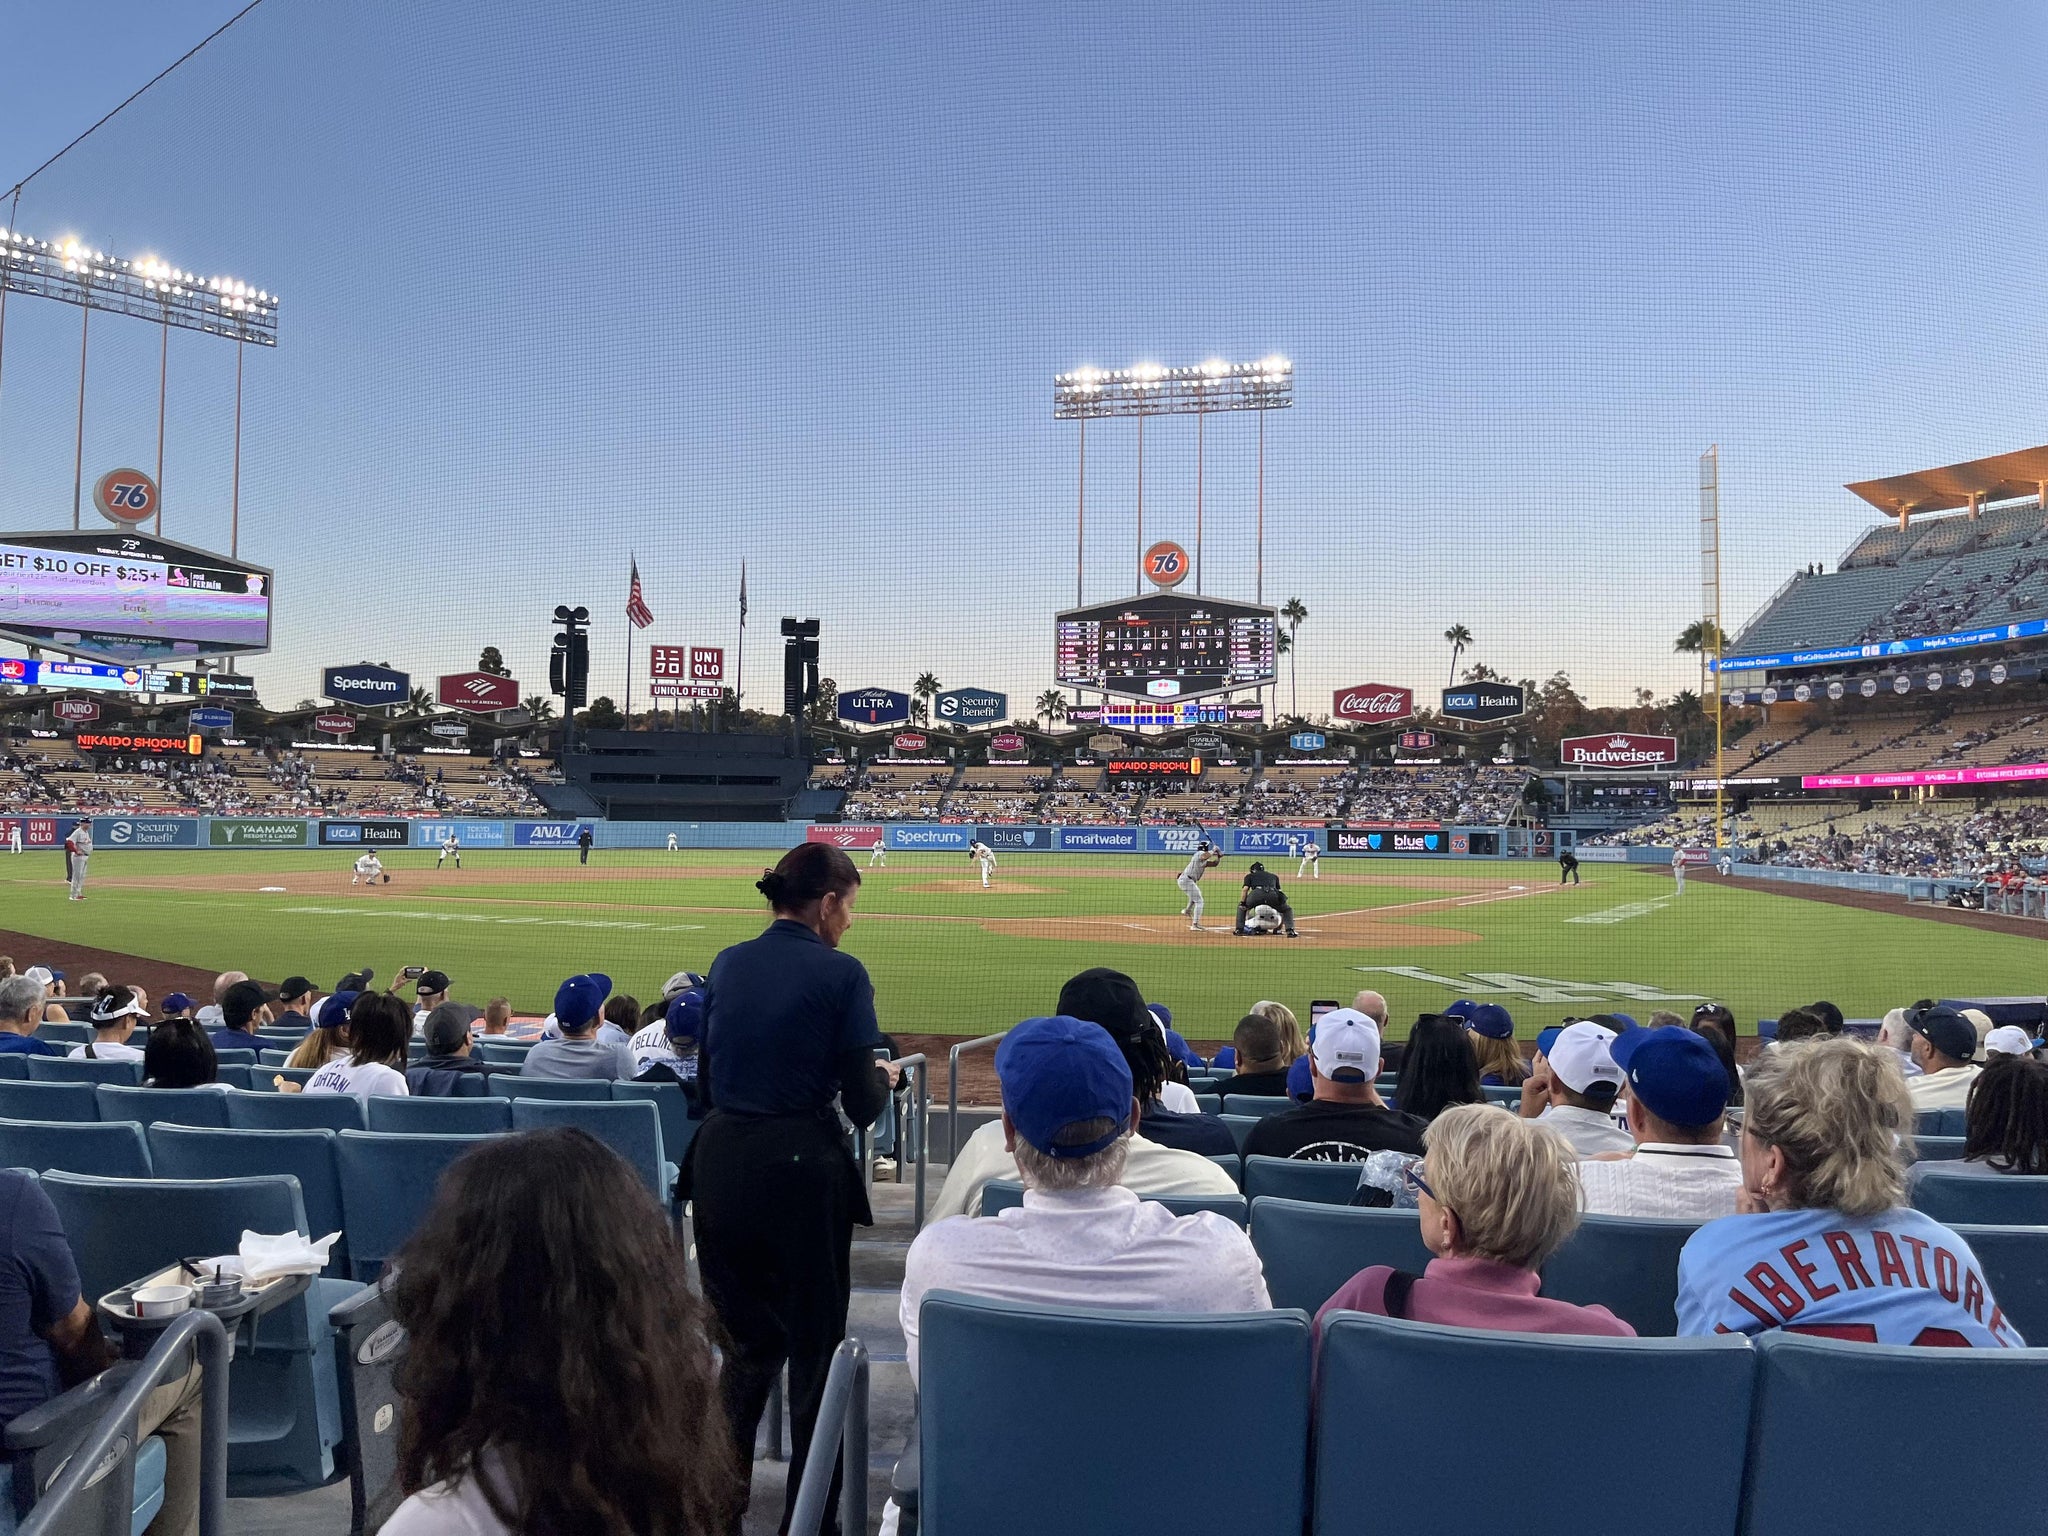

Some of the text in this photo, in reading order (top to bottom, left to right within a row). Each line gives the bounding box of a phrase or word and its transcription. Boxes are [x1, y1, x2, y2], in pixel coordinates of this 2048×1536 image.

[111, 485, 148, 509] 76
[0, 553, 28, 569] ET
[34, 556, 68, 572] $10
[74, 562, 111, 577] OFF
[1152, 552, 1179, 573] 76
[694, 652, 718, 662] UNI
[1756, 658, 1780, 666] Dealers
[694, 664, 720, 676] QLO
[333, 676, 396, 692] Spectrum
[654, 686, 720, 697] UNIQLO FIELD
[852, 698, 894, 709] ULTRA
[962, 697, 1000, 708] Security
[1340, 692, 1405, 714] Coca-Cola
[1448, 695, 1518, 707] UCLA Health
[61, 702, 92, 715] JINRO
[962, 707, 996, 717] Benefit
[318, 720, 352, 728] Yakult
[77, 734, 132, 746] NIKAIDO
[134, 738, 186, 749] SHOCHU
[895, 736, 925, 748] Churu
[1294, 736, 1320, 748] TEL
[1108, 761, 1189, 771] NIKAIDO SHOCHU
[30, 822, 52, 832] UNI
[136, 822, 180, 833] Security
[331, 828, 402, 838] UCLA Health
[530, 826, 562, 838] ANA
[30, 832, 52, 843] QLO
[136, 832, 174, 844] Benefit
[896, 830, 956, 844] Spectrum
[994, 830, 1022, 842] blue
[1064, 833, 1132, 845] smartwater
[1158, 830, 1200, 840] TOYO
[1250, 833, 1308, 846] 木下グルプ
[1338, 834, 1368, 845] blue
[1394, 834, 1424, 846] blue
[1452, 839, 1466, 848] 76
[314, 1072, 351, 1094] OHTANI
